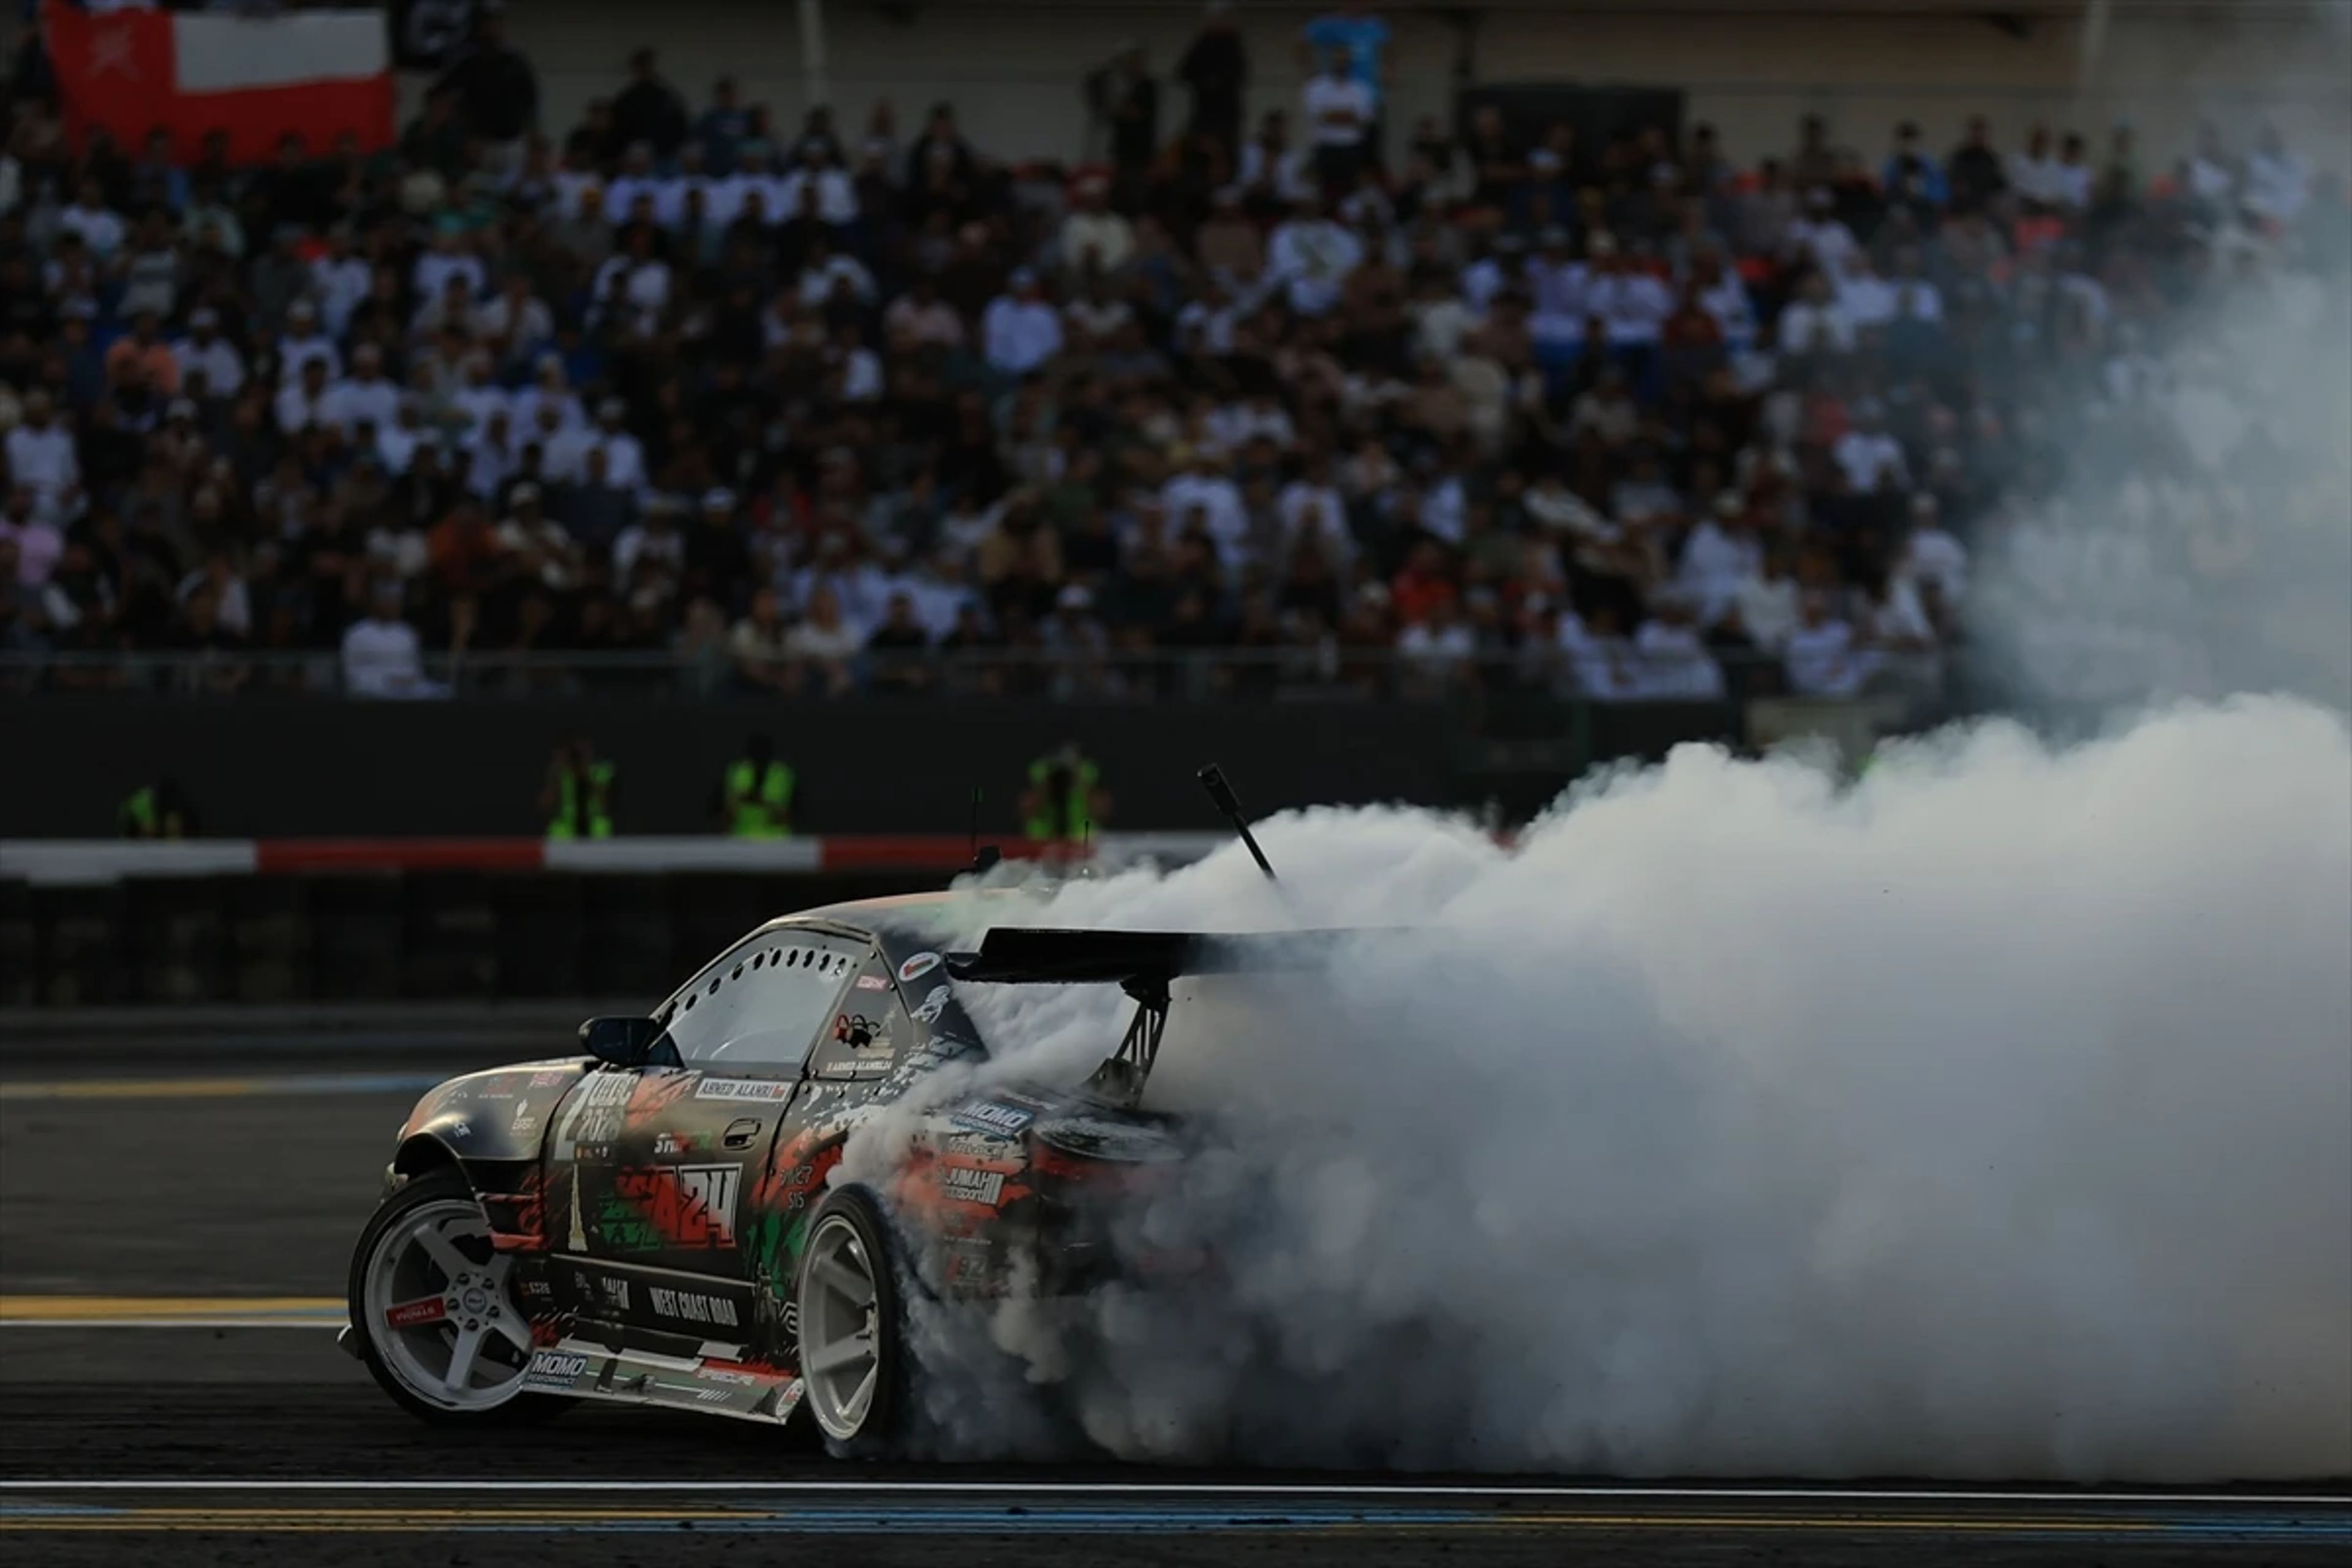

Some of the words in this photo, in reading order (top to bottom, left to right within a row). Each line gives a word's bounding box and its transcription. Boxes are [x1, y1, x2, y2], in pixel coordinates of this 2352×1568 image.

[962, 1101, 1029, 1128] MOMO
[648, 1287, 679, 1318] WEST
[677, 1291, 712, 1323] COAST
[531, 1354, 587, 1376] MOMO
